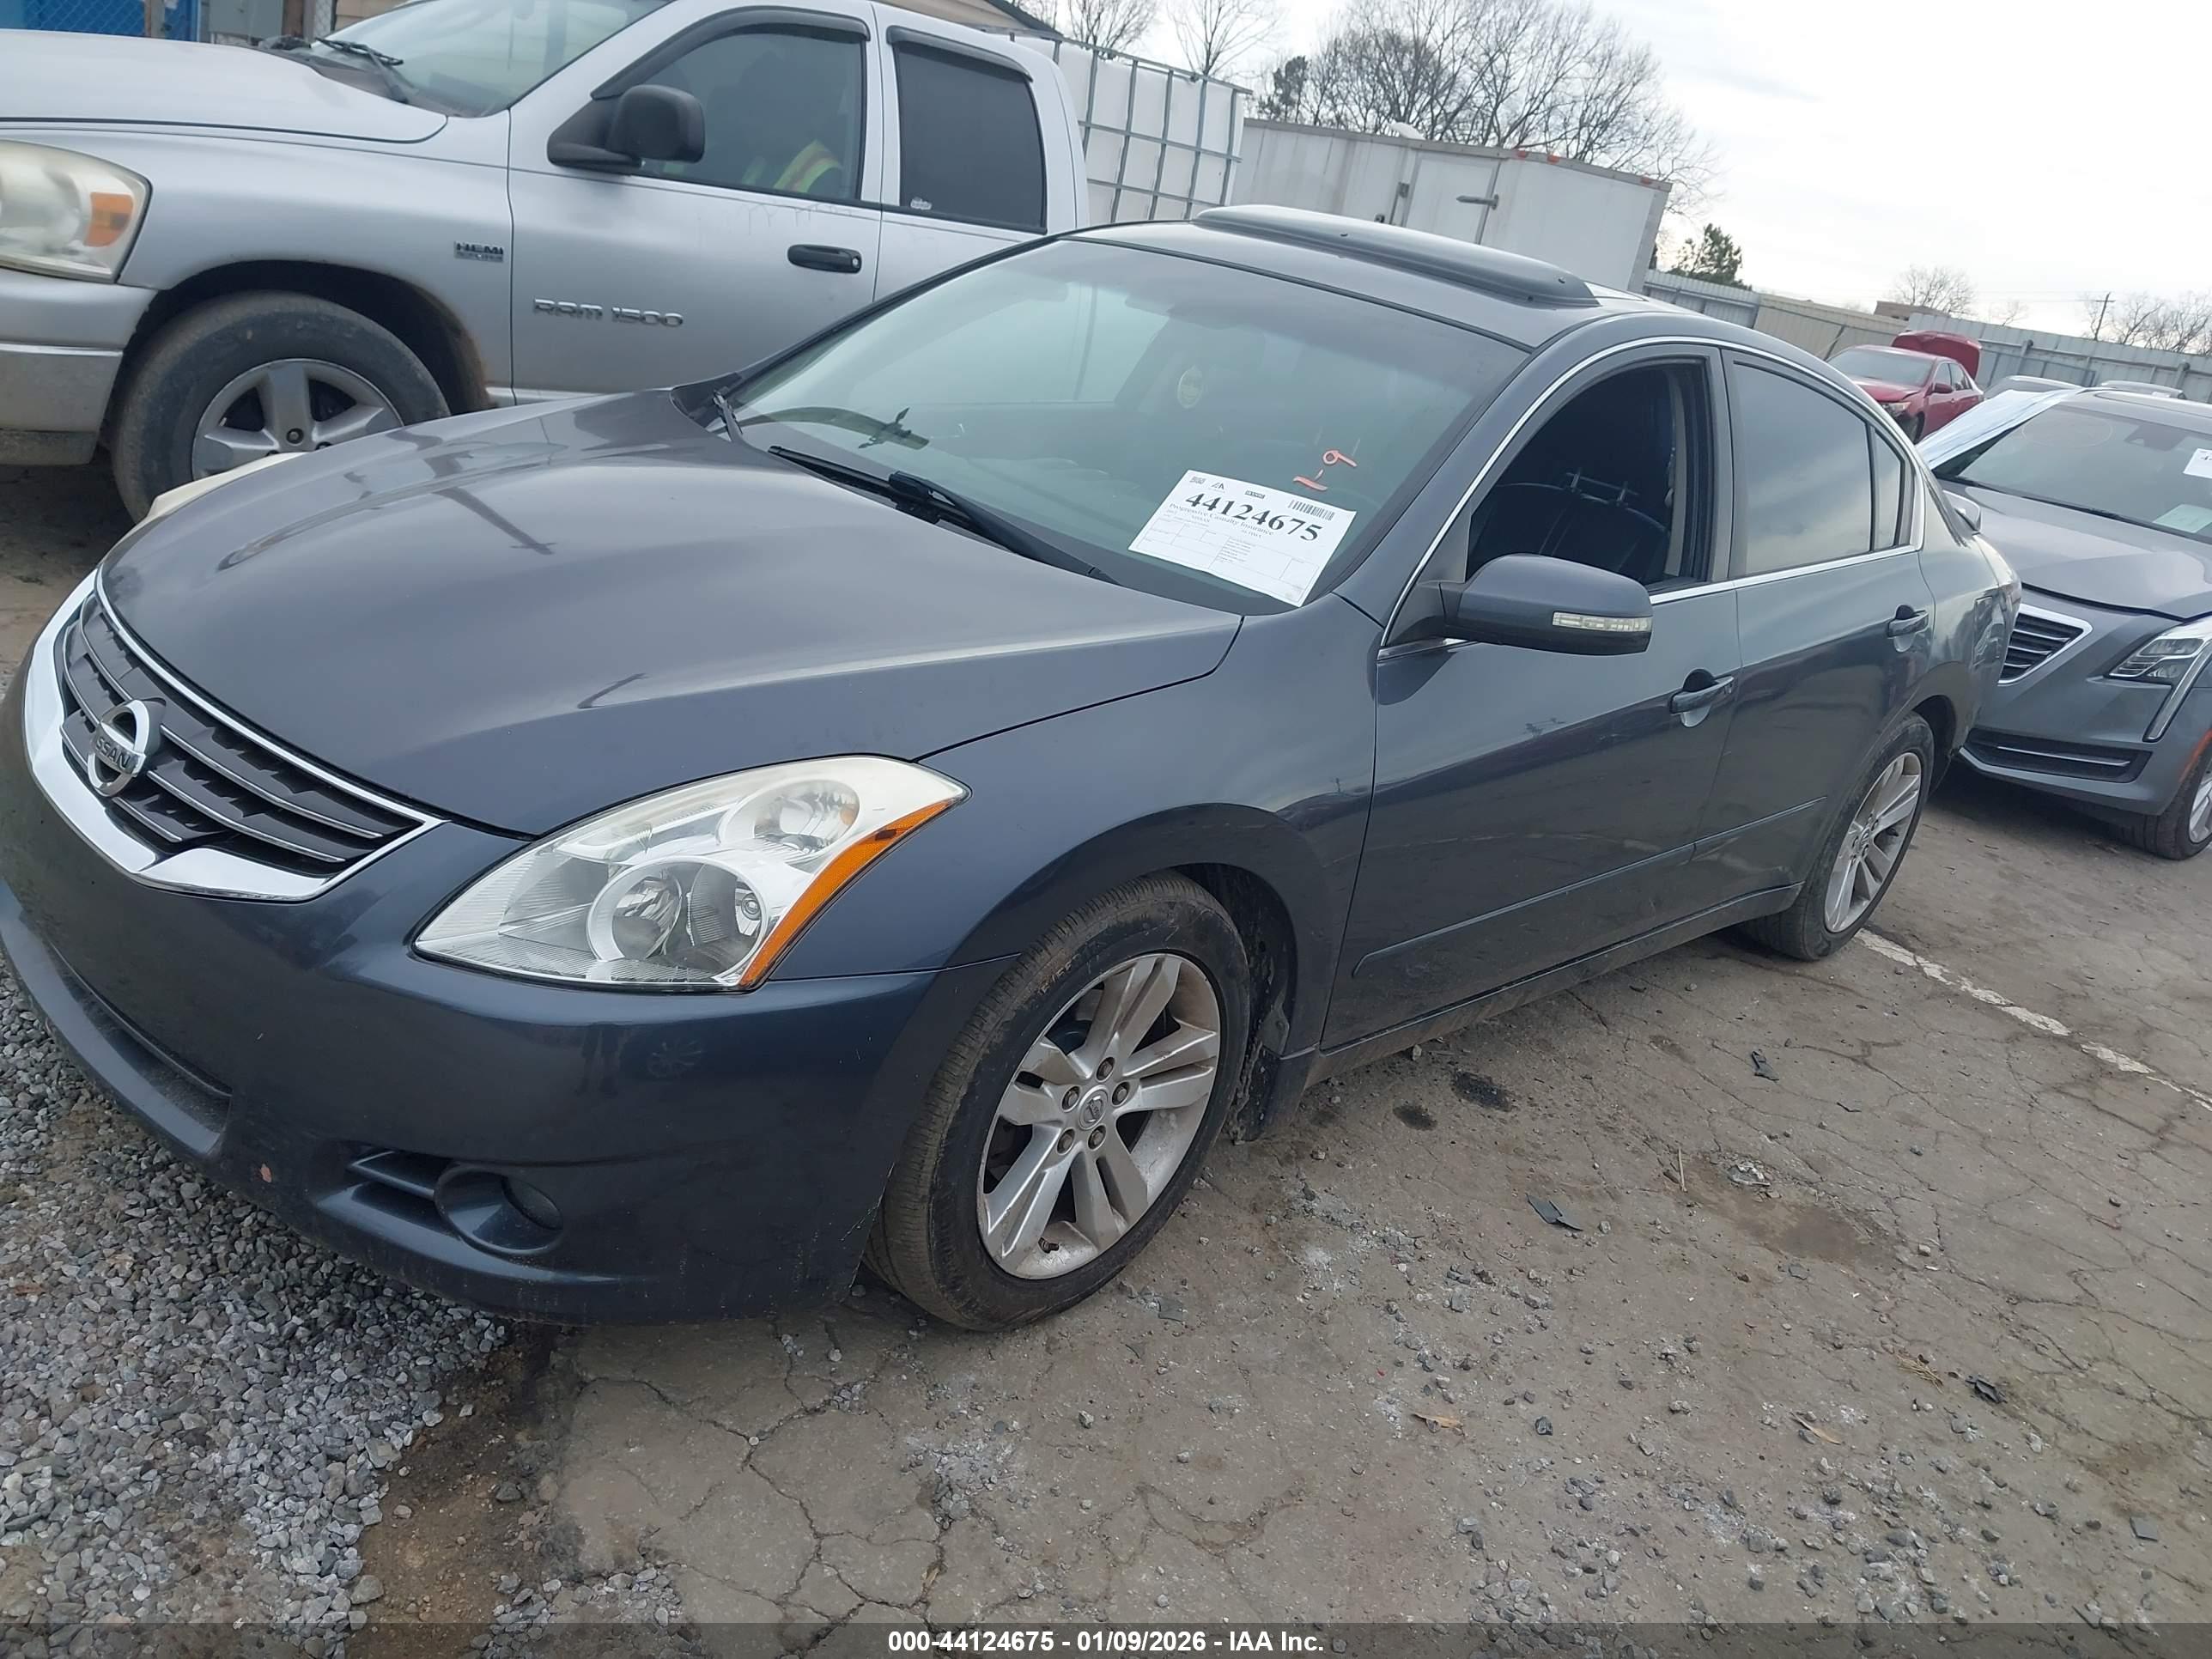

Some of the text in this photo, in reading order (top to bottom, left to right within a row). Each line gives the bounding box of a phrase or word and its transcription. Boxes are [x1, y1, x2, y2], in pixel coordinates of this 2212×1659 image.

[456, 242, 503, 255] HEMI
[533, 298, 684, 328] RAM 1500
[1185, 493, 1323, 541] 44124675
